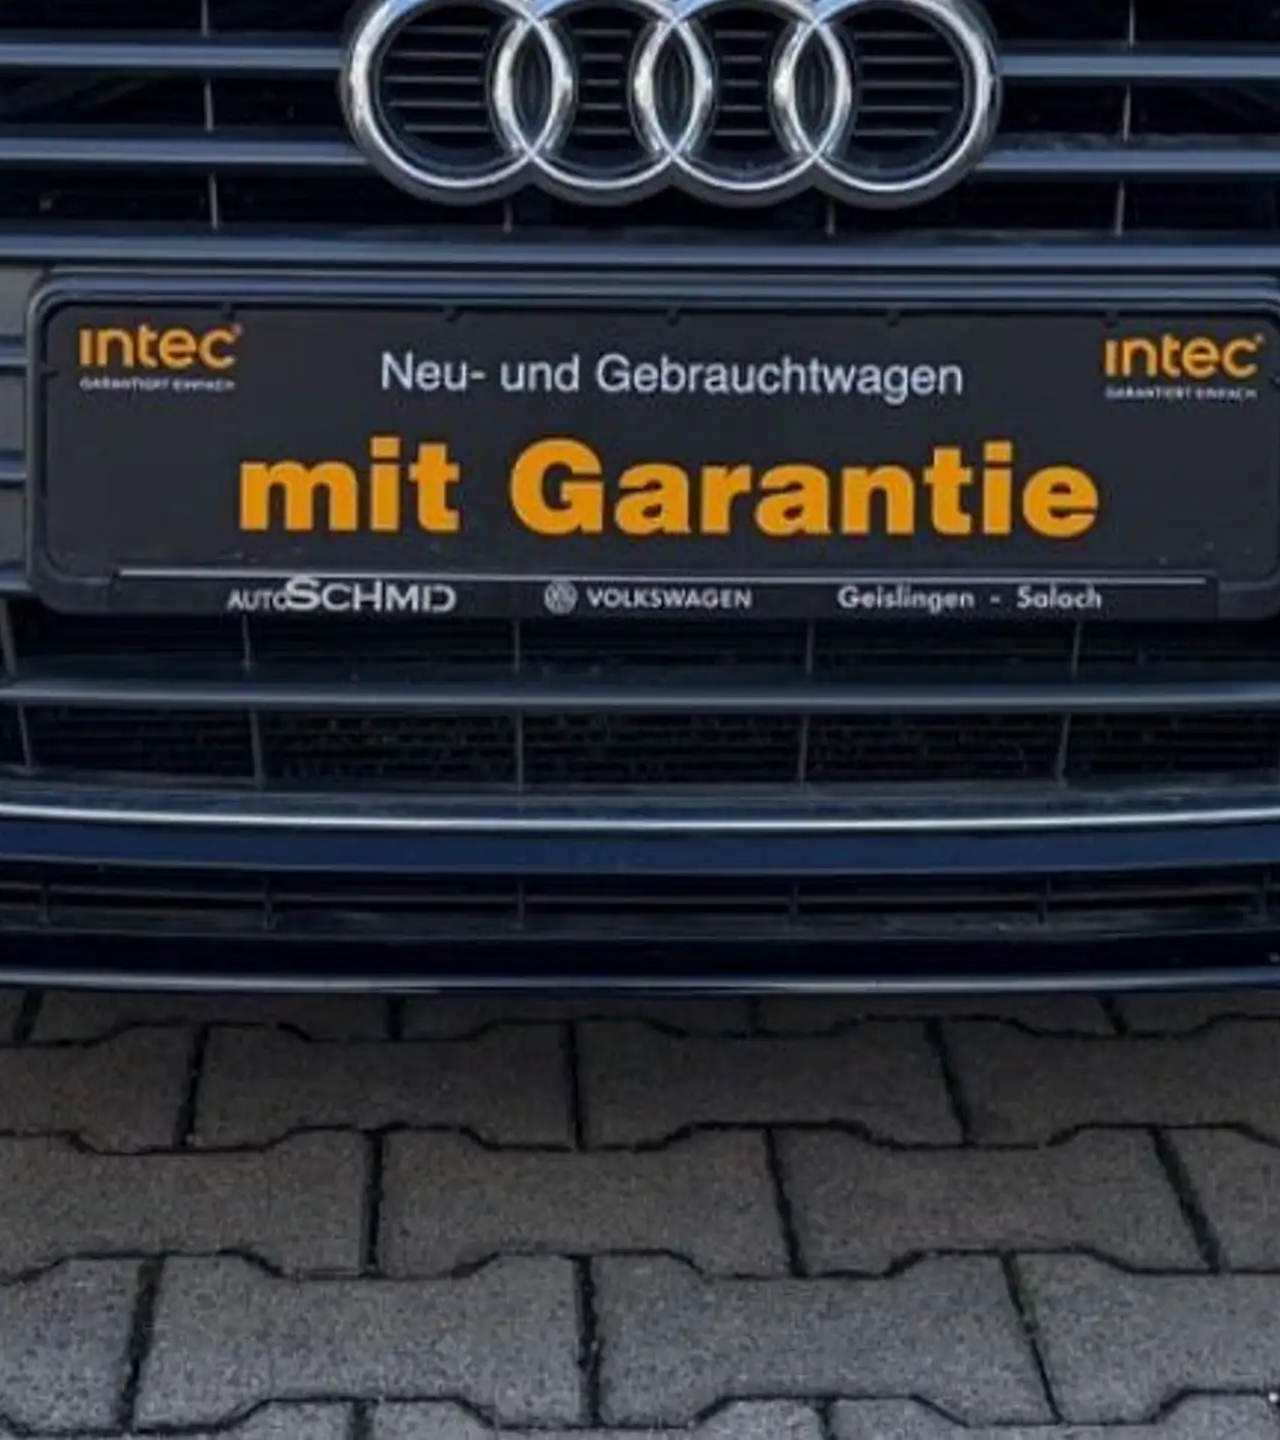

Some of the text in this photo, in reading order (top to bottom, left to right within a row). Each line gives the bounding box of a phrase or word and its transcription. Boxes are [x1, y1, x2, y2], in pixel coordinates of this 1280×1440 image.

[79, 324, 236, 369] intec
[1105, 334, 1258, 379] intec
[381, 351, 963, 404] Neu- und Gebrauchtwagen
[239, 436, 1100, 536] mit Garantie
[587, 587, 752, 609] VOLKSWAGEN
[837, 584, 975, 614] Geislingen
